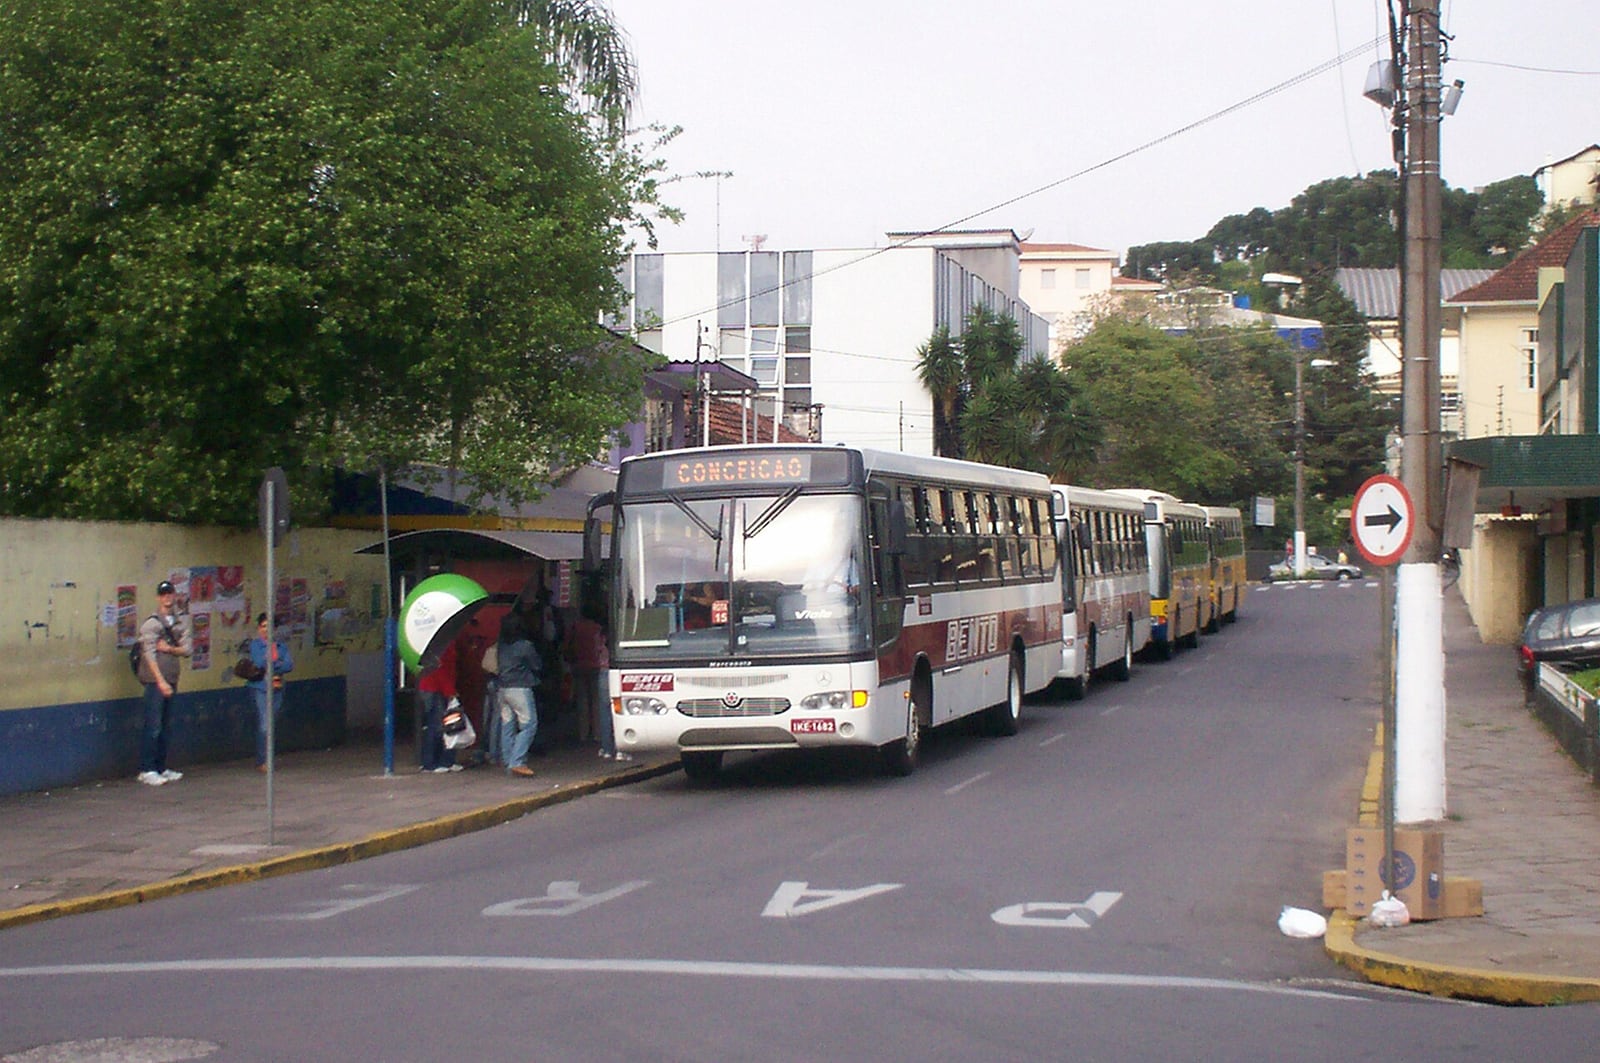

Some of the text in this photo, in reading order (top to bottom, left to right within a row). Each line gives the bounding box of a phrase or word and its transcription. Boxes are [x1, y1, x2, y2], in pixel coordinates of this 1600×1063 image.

[678, 456, 802, 483] CONCEICAO
[715, 612, 728, 623] 15
[945, 613, 999, 661] BENTO
